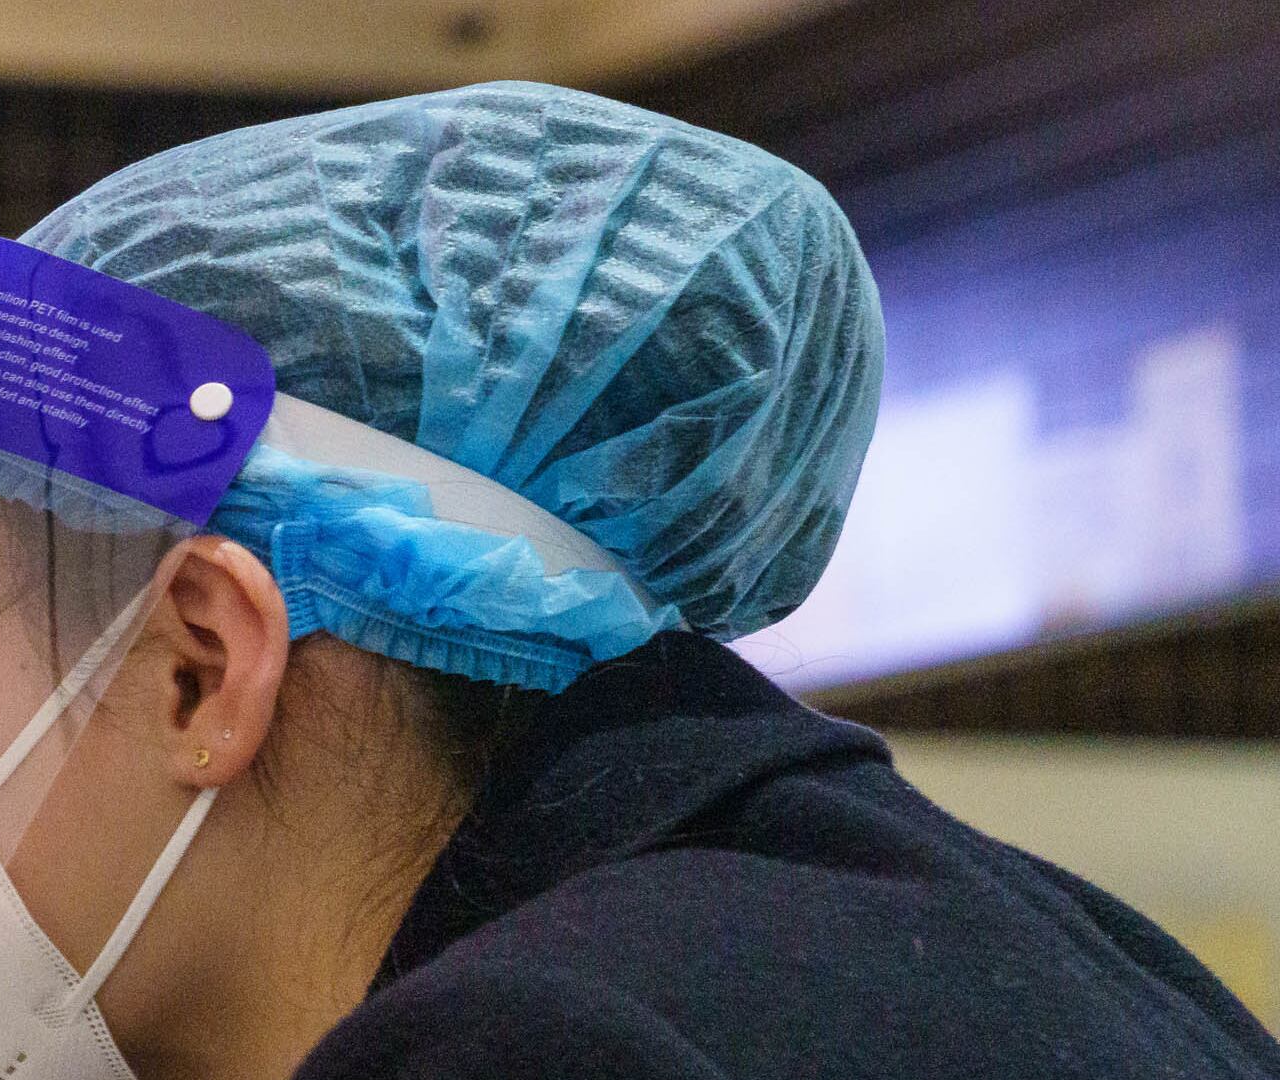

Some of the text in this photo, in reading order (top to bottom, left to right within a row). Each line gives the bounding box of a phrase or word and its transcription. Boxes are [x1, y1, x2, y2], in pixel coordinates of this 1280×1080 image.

[29, 300, 57, 316] PET
[56, 310, 78, 325] film
[79, 320, 91, 330] is
[91, 326, 123, 342] used
[43, 346, 78, 364] effect
[2, 371, 24, 384] can
[24, 379, 49, 393] also
[50, 388, 73, 402] use
[74, 396, 105, 414] them
[105, 408, 152, 434] directly
[29, 361, 62, 378] good
[60, 372, 122, 400] protection
[122, 396, 159, 416] effect
[17, 395, 42, 410] and
[41, 404, 88, 428] stability
